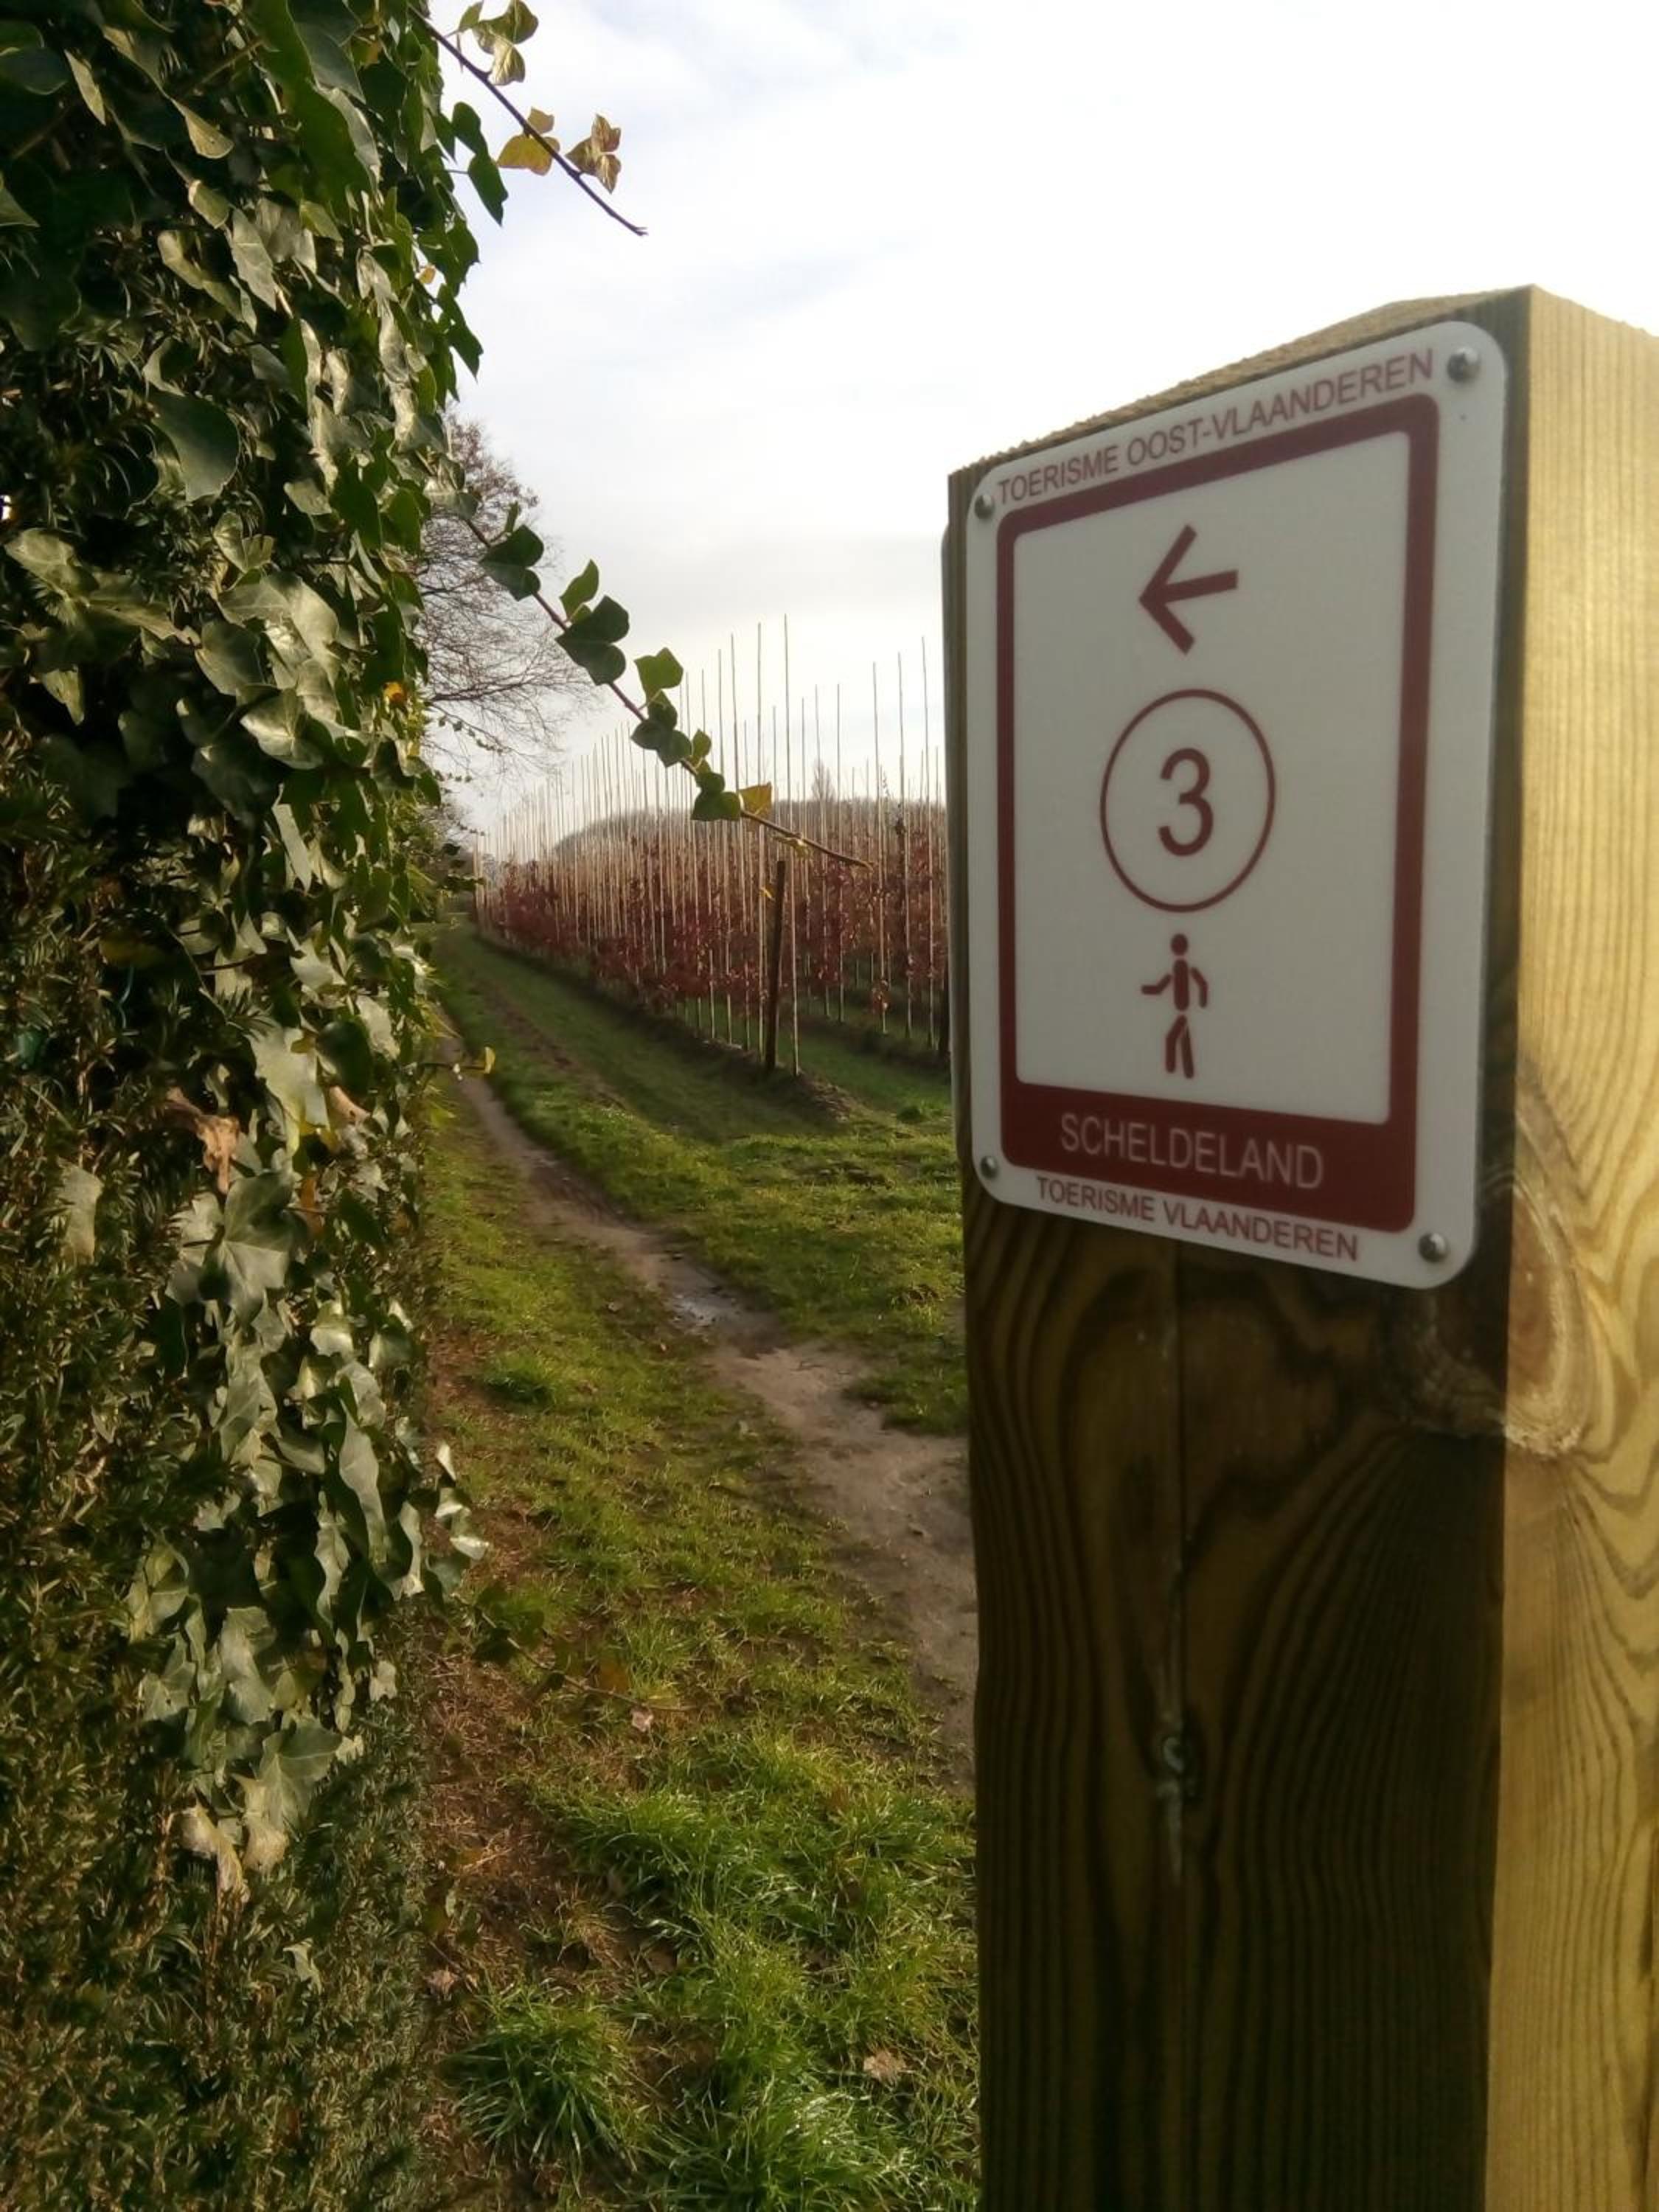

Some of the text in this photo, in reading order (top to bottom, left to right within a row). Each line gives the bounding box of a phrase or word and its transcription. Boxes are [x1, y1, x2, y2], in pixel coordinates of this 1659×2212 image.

[998, 348, 1433, 504] TOERISME OOST-VLAANDEREN
[1158, 747, 1214, 857] 3
[1061, 1112, 1323, 1189] SCHELDELAND
[1036, 1176, 1360, 1262] TOERISME VLAANDEREN
